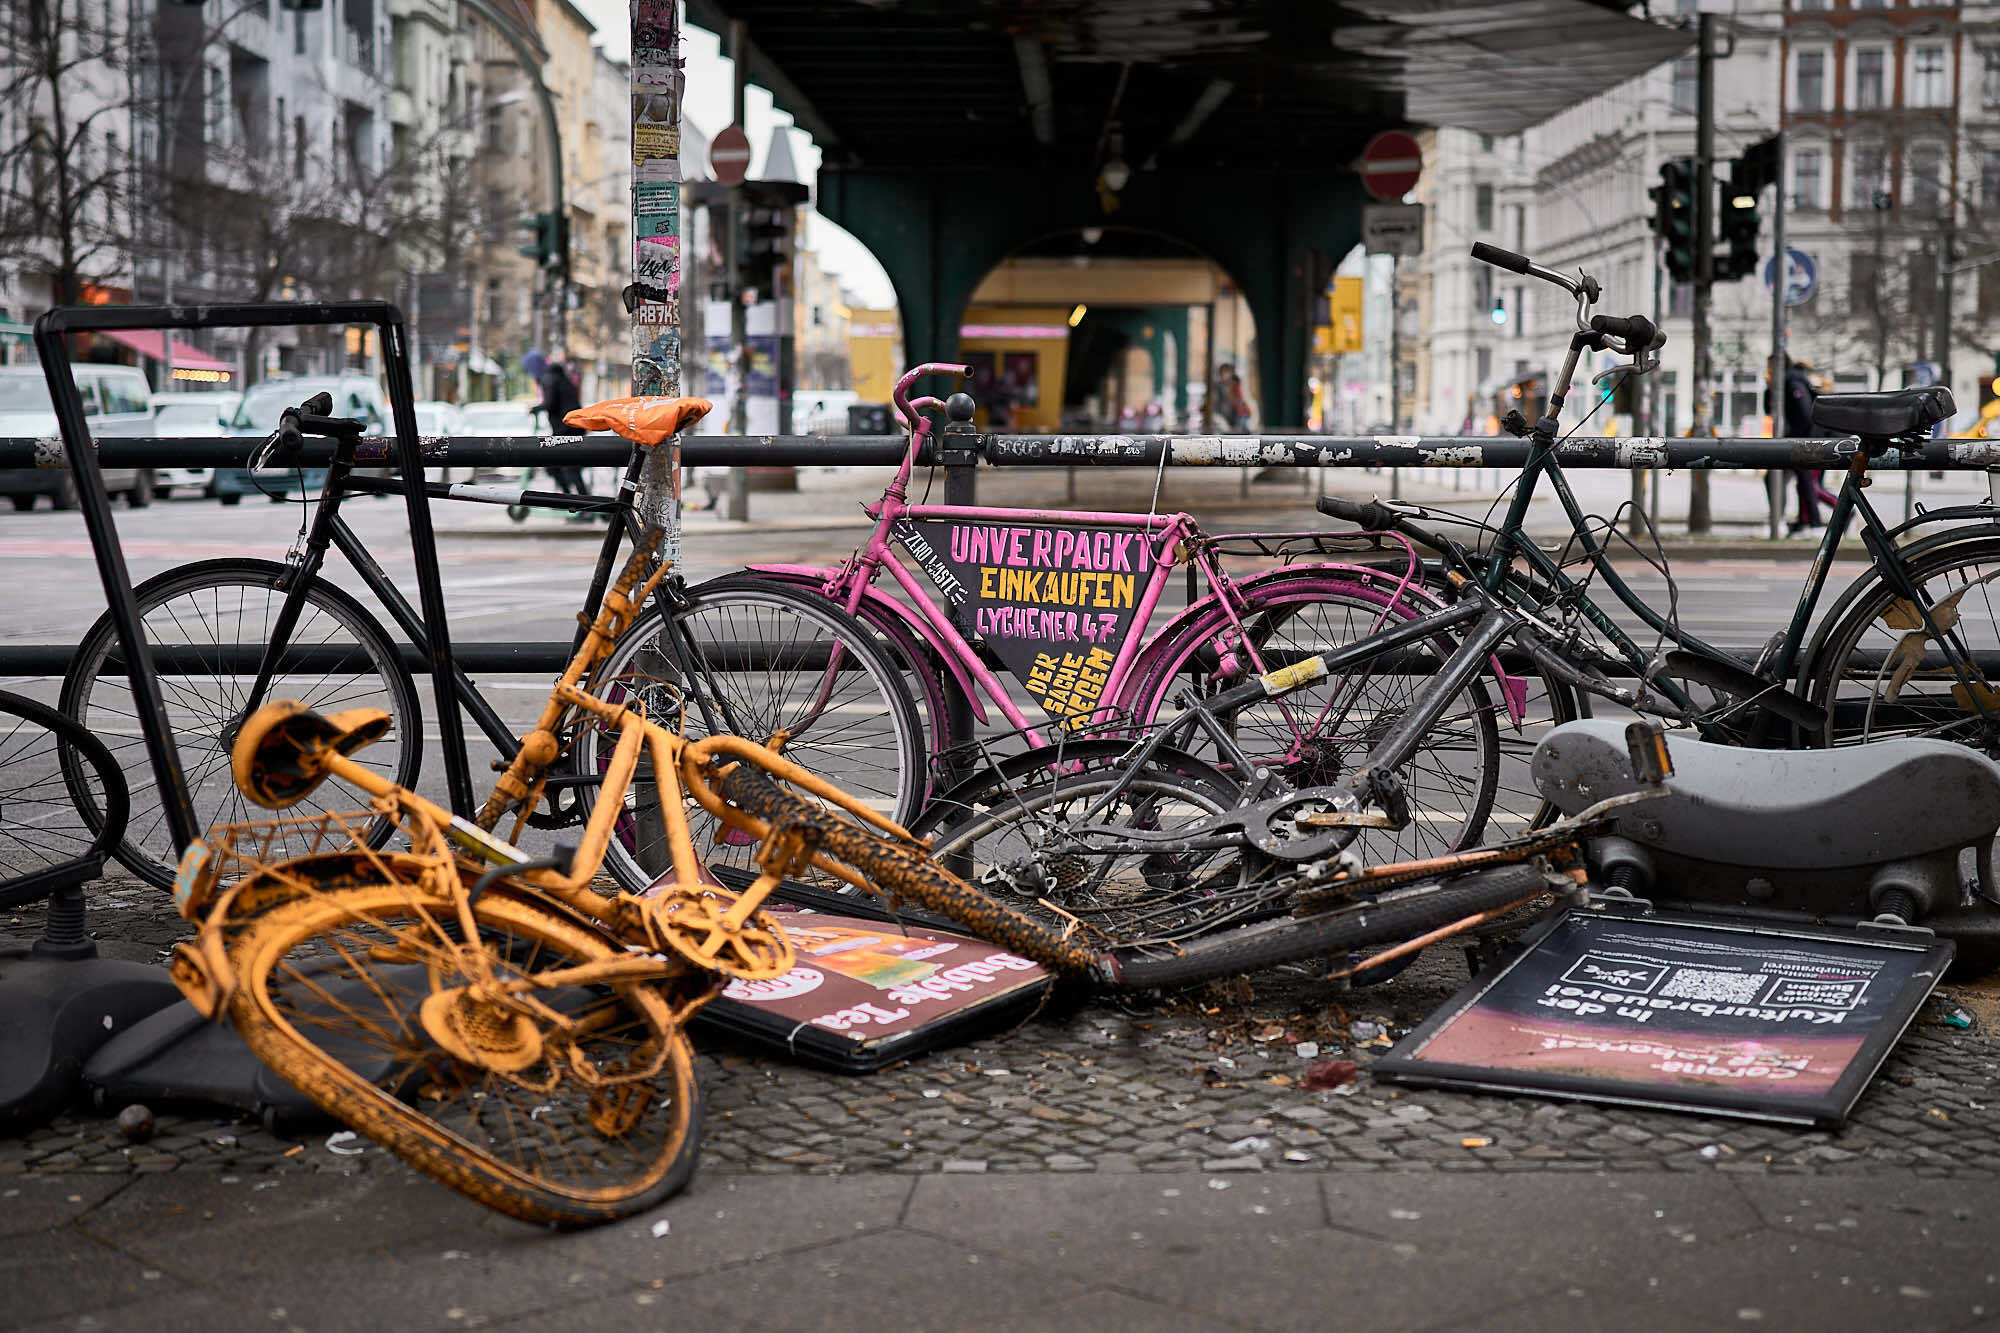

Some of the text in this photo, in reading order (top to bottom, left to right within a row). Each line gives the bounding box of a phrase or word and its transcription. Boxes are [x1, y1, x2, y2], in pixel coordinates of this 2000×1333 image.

[951, 526, 1156, 572] UNVERPACKT
[904, 531, 961, 597] ZERO WASTE
[980, 567, 1135, 608] EINKAUFEN
[976, 606, 1118, 644] LYCHENER 47
[1025, 652, 1060, 695] DER
[1043, 652, 1084, 714] SACHE
[1591, 976, 1631, 986] Nur
[1763, 962, 1870, 977] Kulturbrauerei
[811, 953, 1039, 1029] Bubble Tea
[1776, 996, 1845, 1006] Termin
[1783, 990, 1850, 1000] Online
[1787, 984, 1855, 993] Buchen
[1537, 998, 1607, 1016] der
[1544, 984, 1847, 1024] Kulturbrauerei
[1540, 1040, 1718, 1065] Labortest
[1728, 1056, 1810, 1071] PCR
[1650, 1060, 1798, 1080] Corona-
